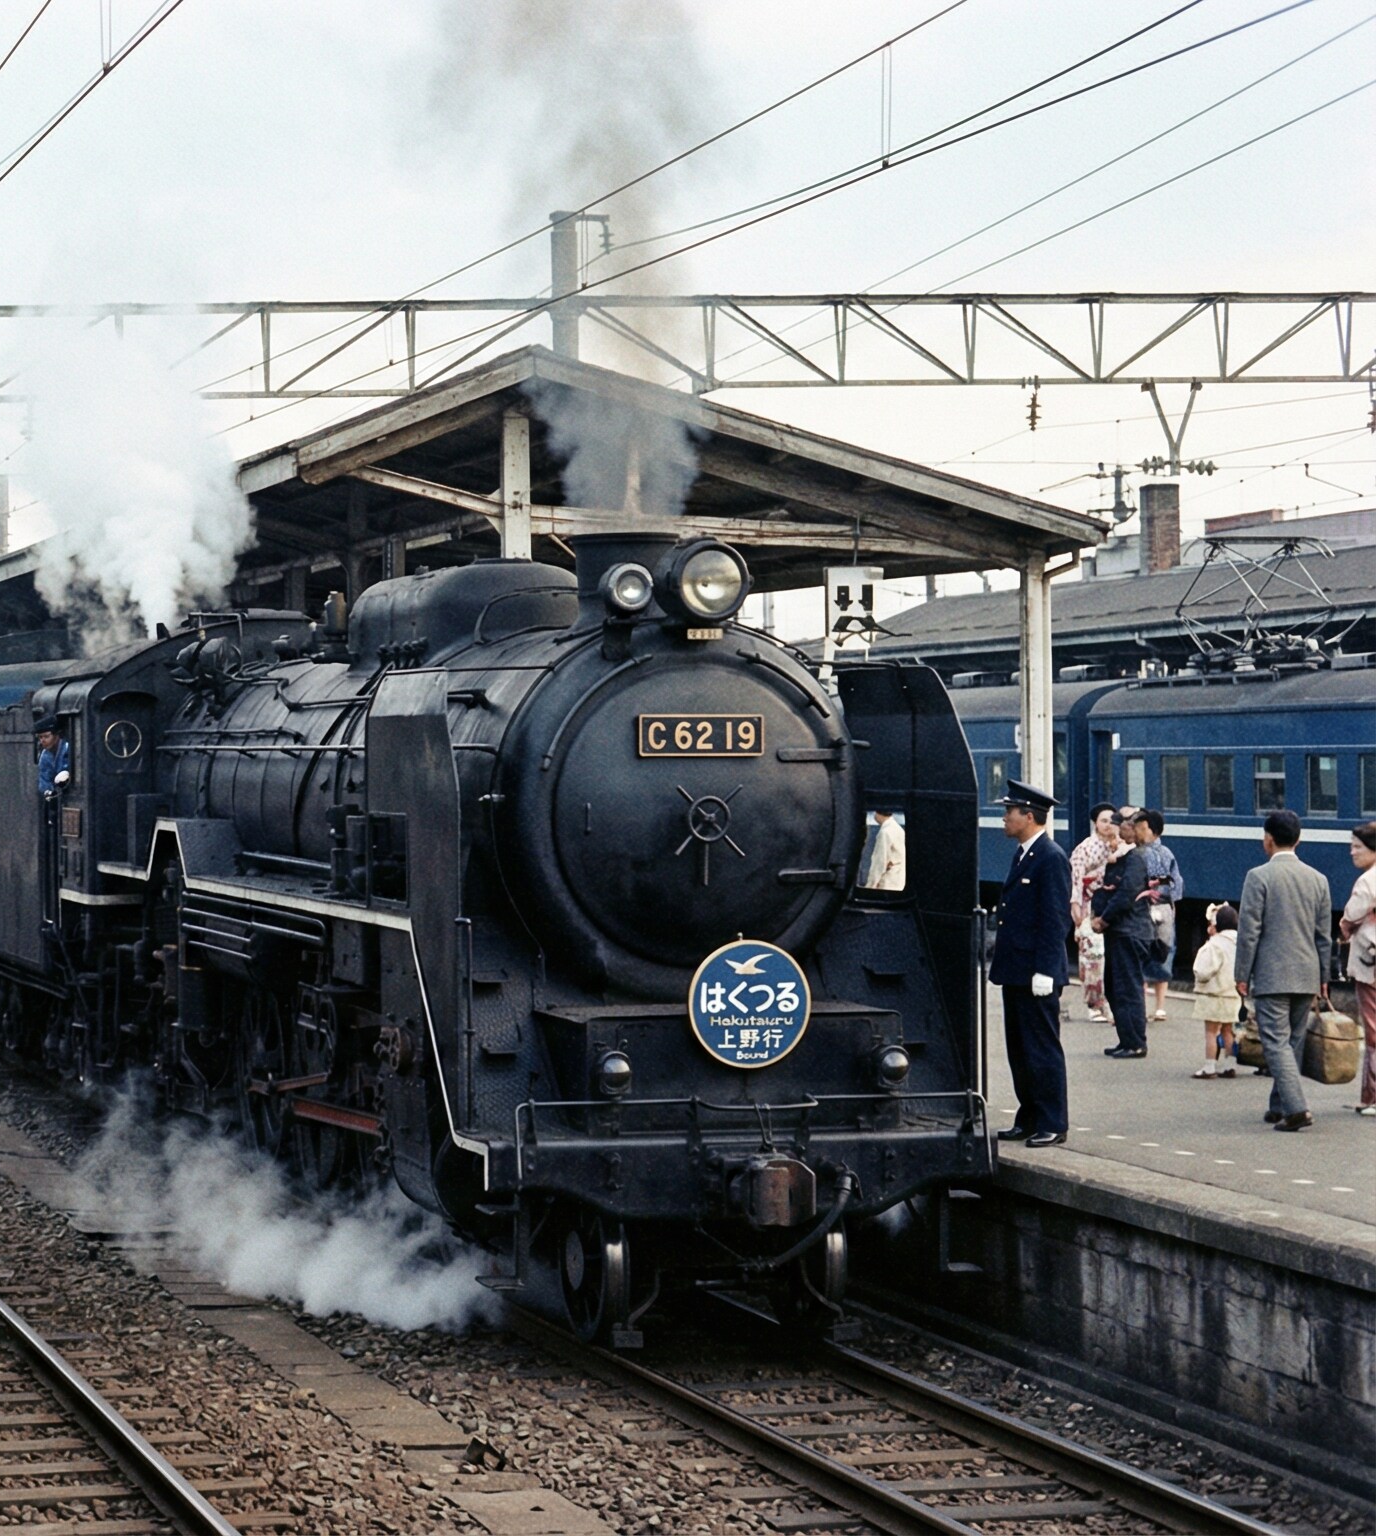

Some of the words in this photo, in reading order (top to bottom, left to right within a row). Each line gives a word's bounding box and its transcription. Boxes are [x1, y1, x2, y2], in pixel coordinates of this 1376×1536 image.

[725, 721, 756, 750] 19
[700, 981, 800, 1014] はくつる
[717, 1028, 784, 1049] 上野行
